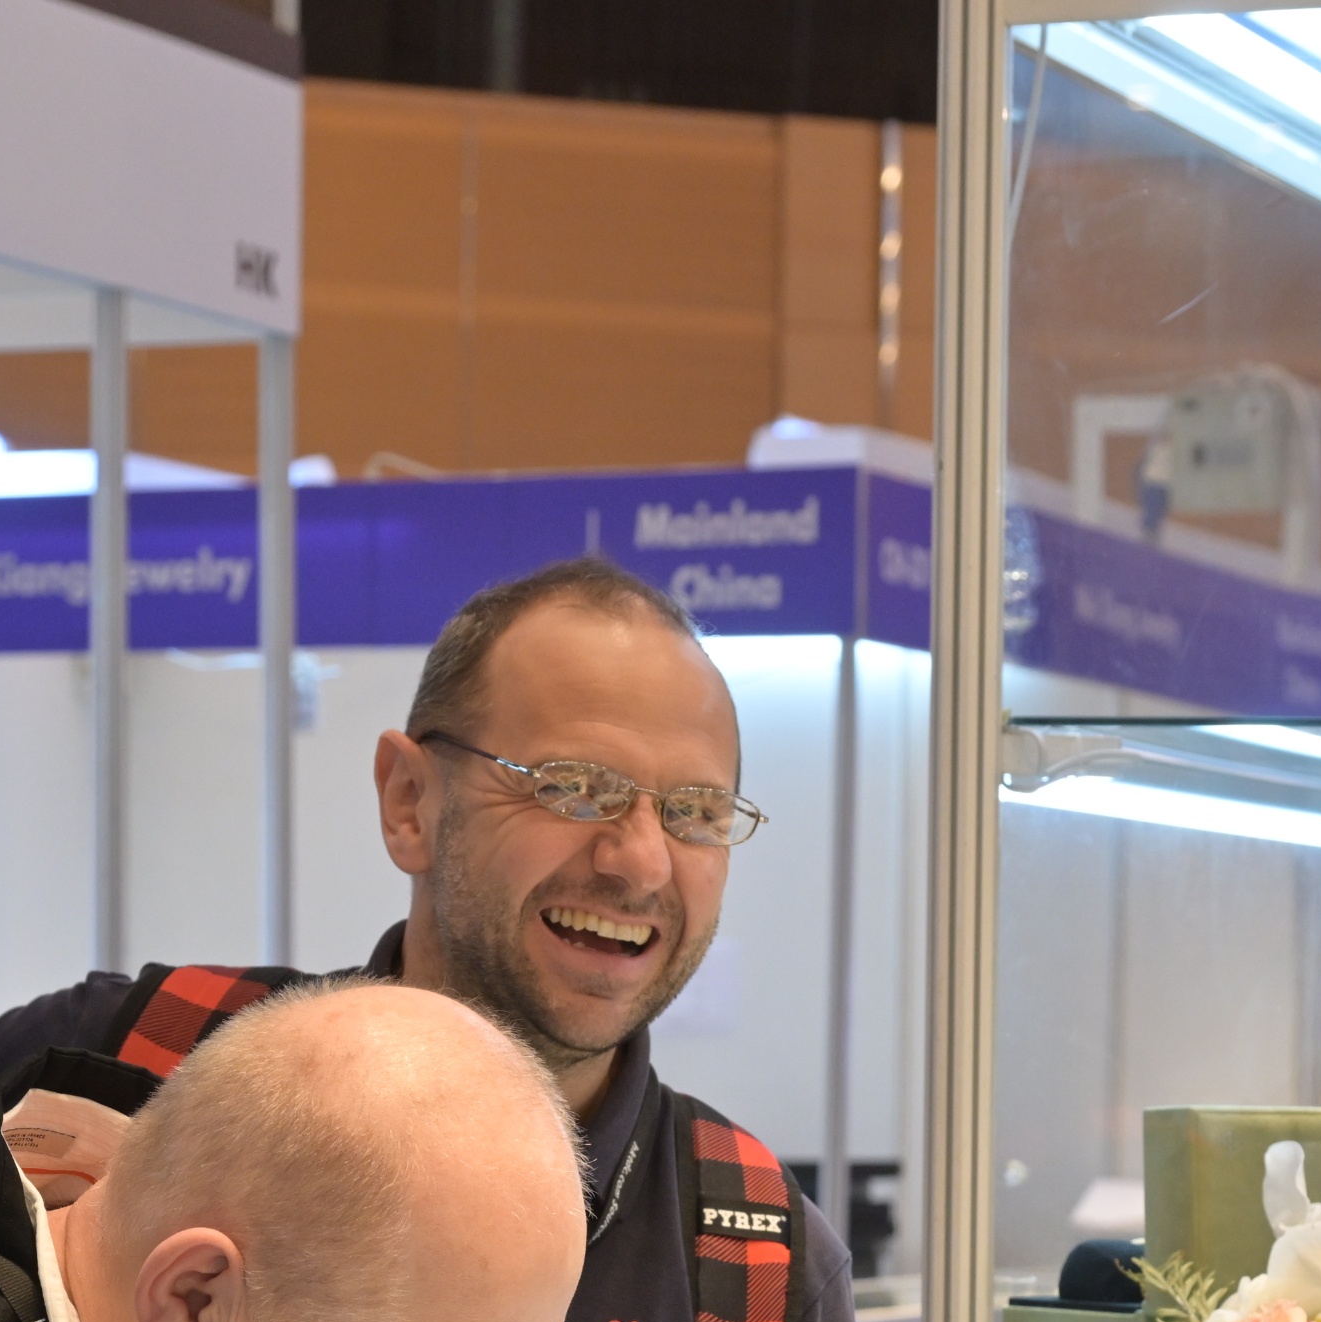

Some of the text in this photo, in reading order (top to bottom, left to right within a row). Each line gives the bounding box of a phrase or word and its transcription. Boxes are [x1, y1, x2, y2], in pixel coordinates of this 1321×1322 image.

[235, 239, 279, 297] HK
[634, 495, 818, 549] Mainland
[126, 545, 251, 603] ewelry
[671, 562, 782, 612] China
[703, 1208, 782, 1233] PYREX
